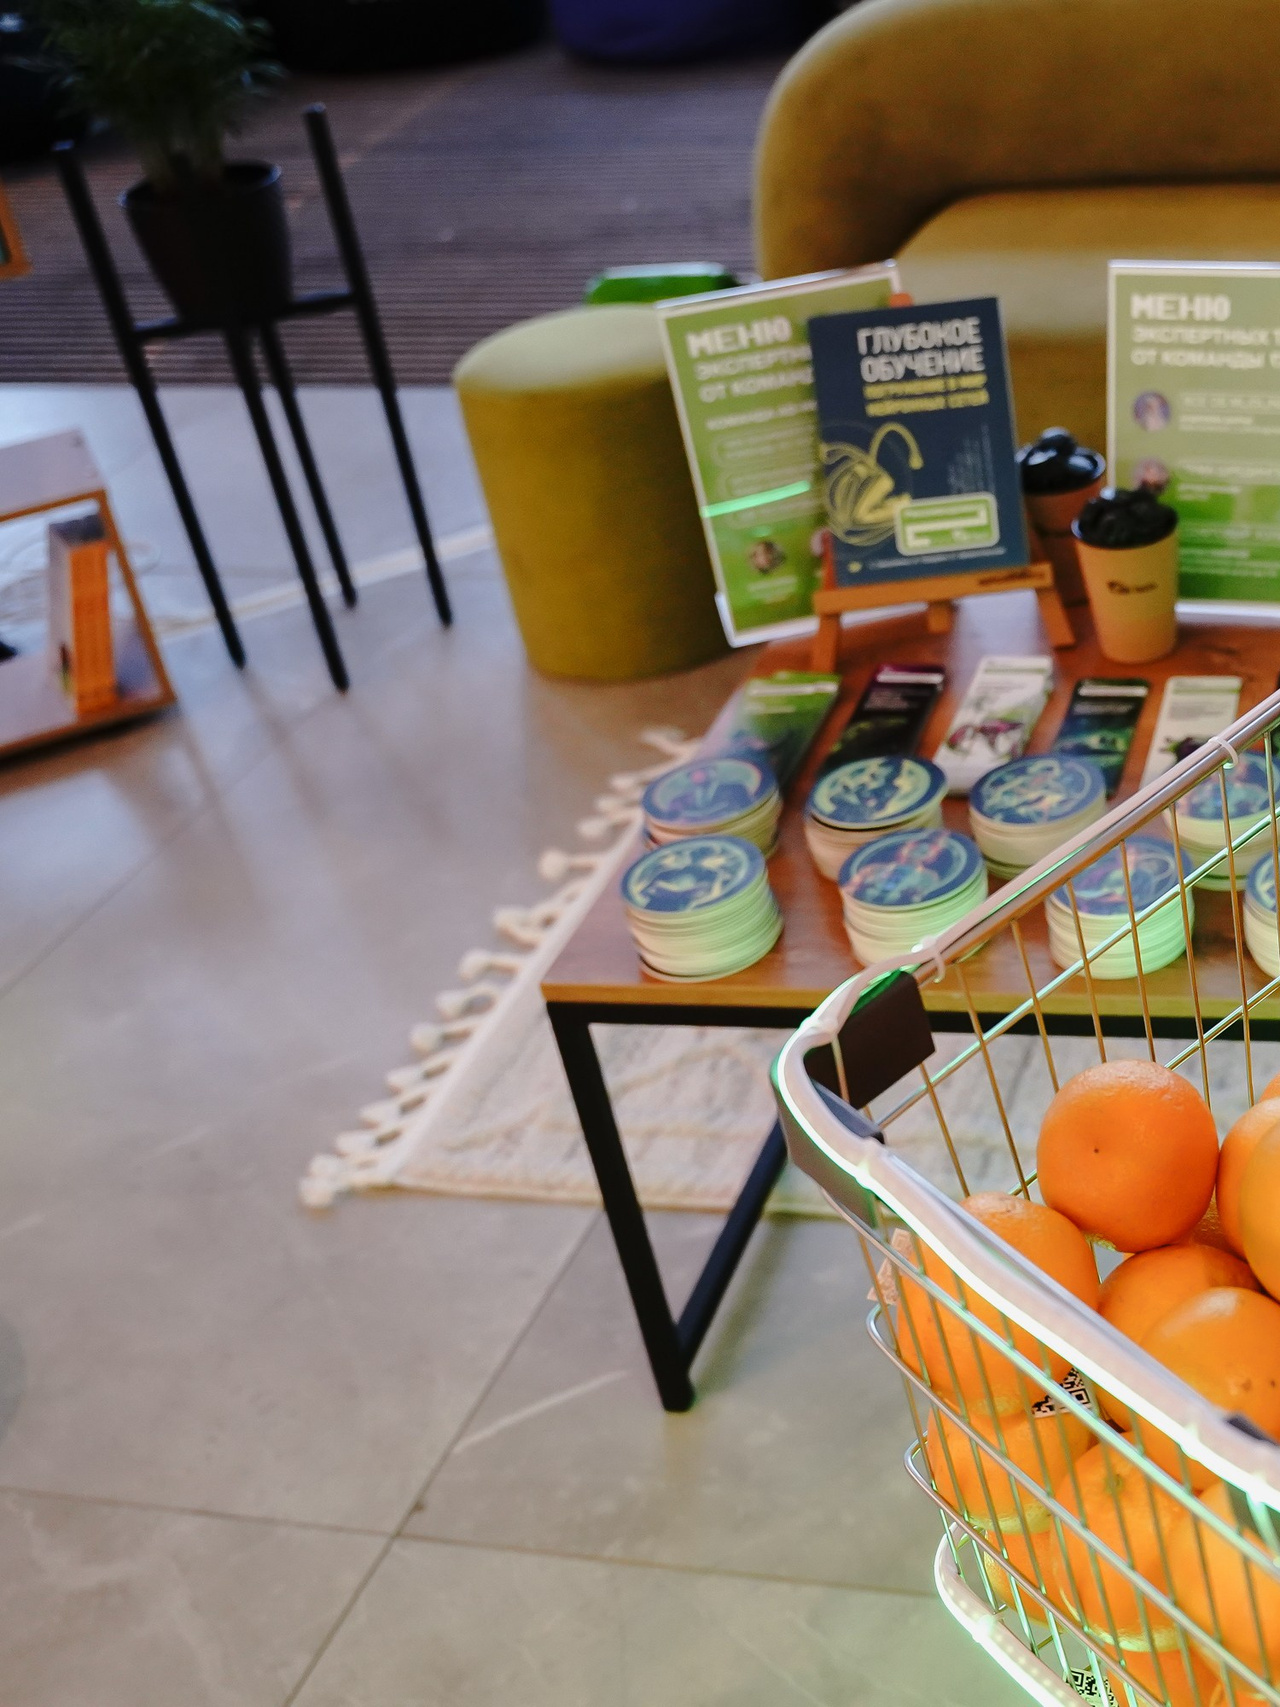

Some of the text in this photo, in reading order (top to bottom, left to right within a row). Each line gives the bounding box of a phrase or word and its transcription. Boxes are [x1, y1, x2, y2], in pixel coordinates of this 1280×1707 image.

[1131, 293, 1232, 322] МЕНЮ
[686, 315, 792, 359] МЕНЮ
[857, 316, 983, 356] ГЛУБОКОЕ
[860, 344, 986, 383] ОБУЧЕНИЕ
[1131, 348, 1157, 366] ОТ
